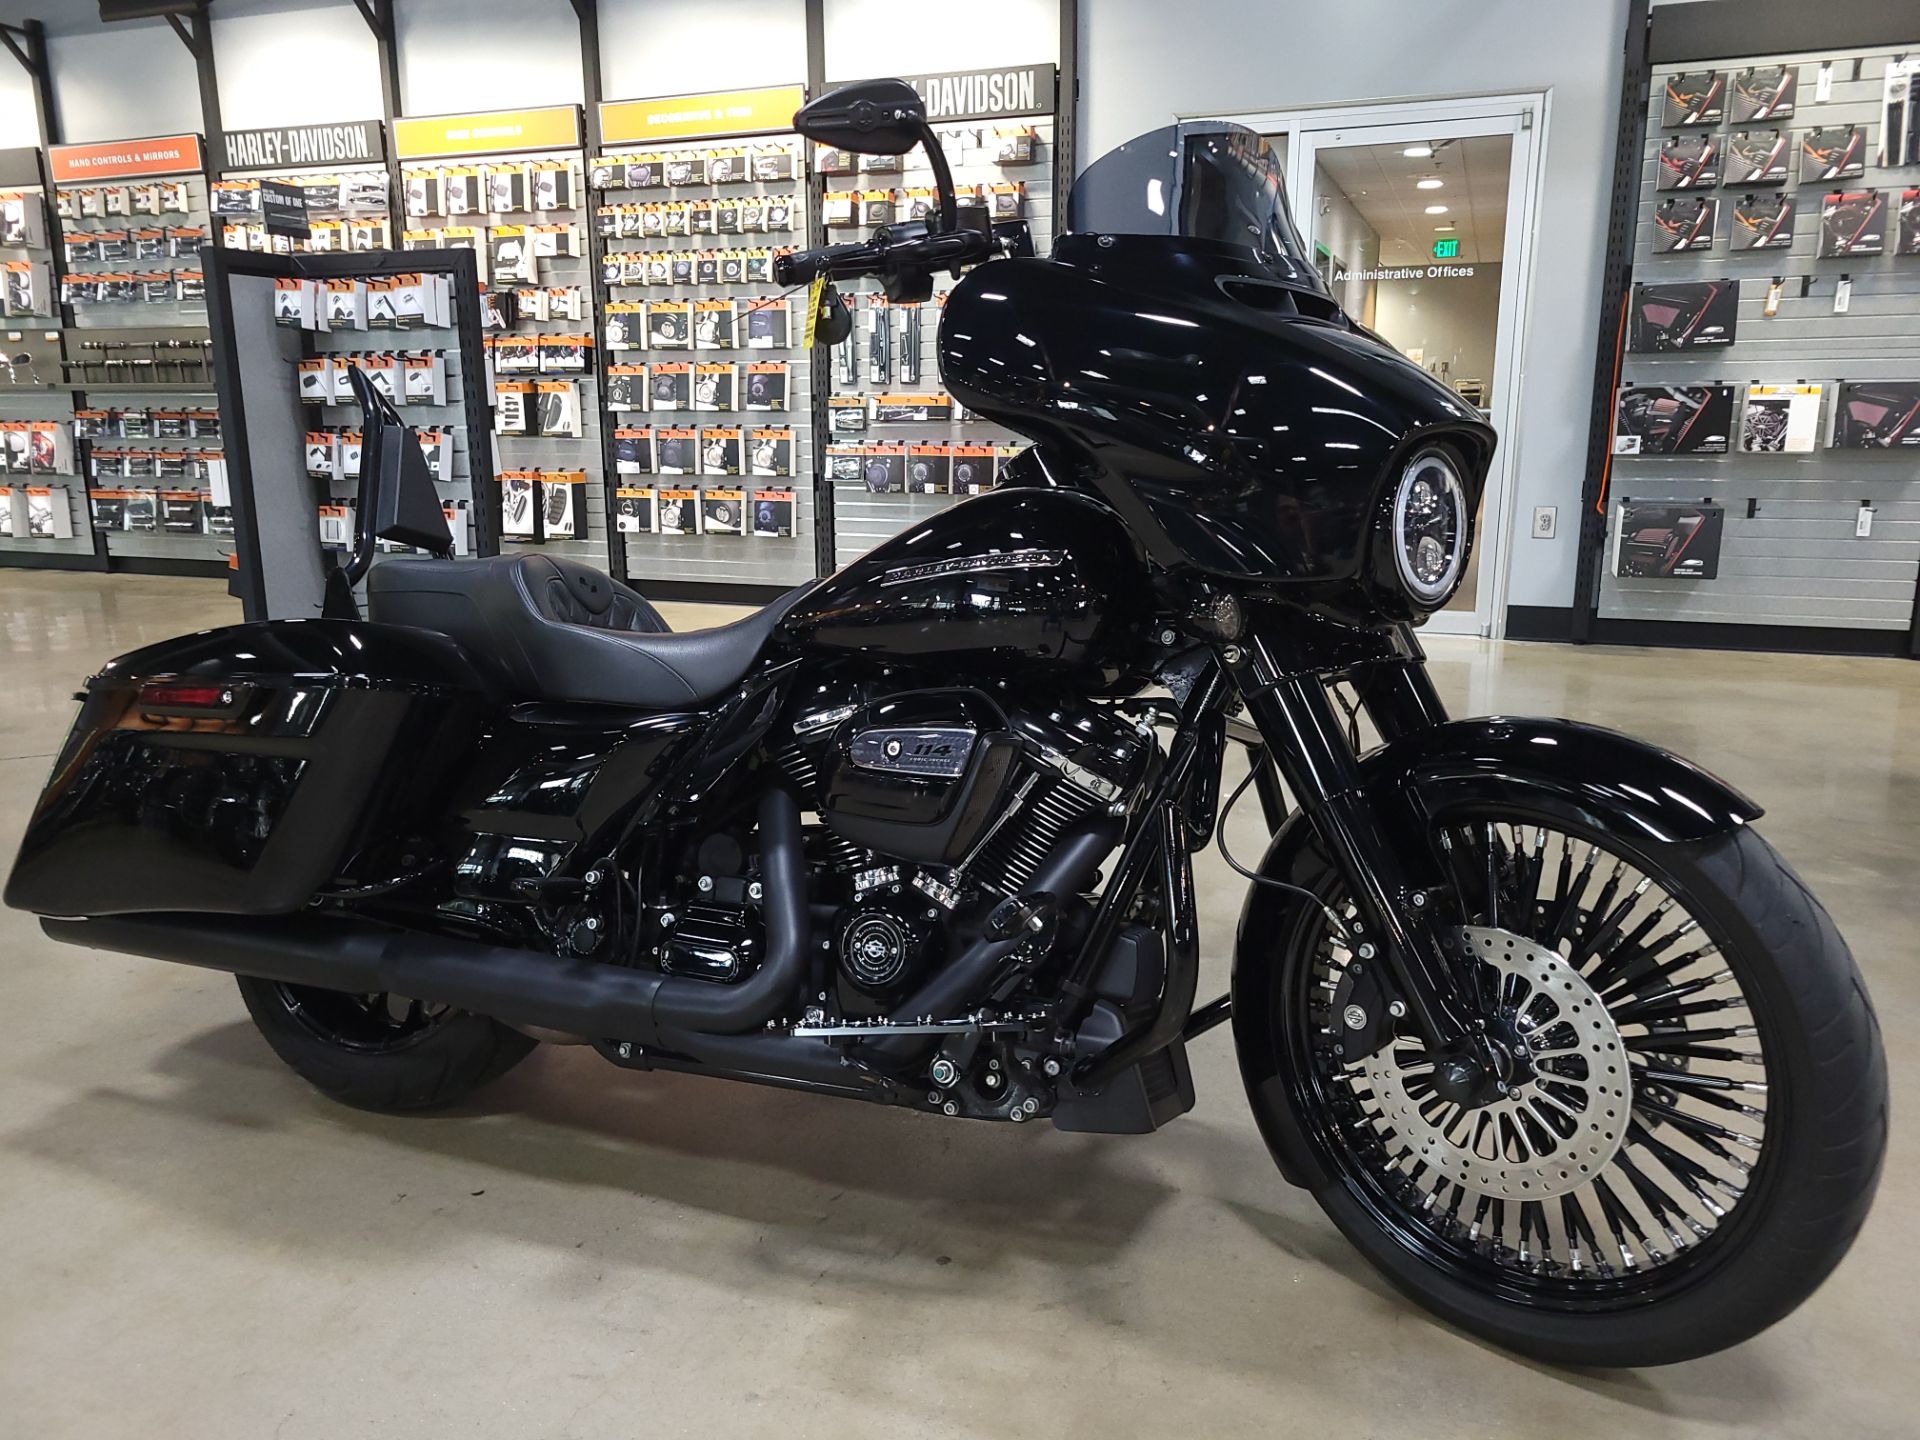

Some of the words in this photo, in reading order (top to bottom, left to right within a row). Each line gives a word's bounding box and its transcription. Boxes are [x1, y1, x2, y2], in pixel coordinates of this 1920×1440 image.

[225, 125, 369, 167] HARLEY-DAVIDSON
[68, 158, 90, 168] HAND
[92, 154, 132, 165] CONTROLS
[134, 153, 141, 162] &
[143, 150, 180, 161] MIRRORS
[1436, 240, 1457, 257] EXIT
[1334, 268, 1423, 281] Administrative
[1427, 266, 1474, 278] Offices
[914, 743, 955, 757] 114
